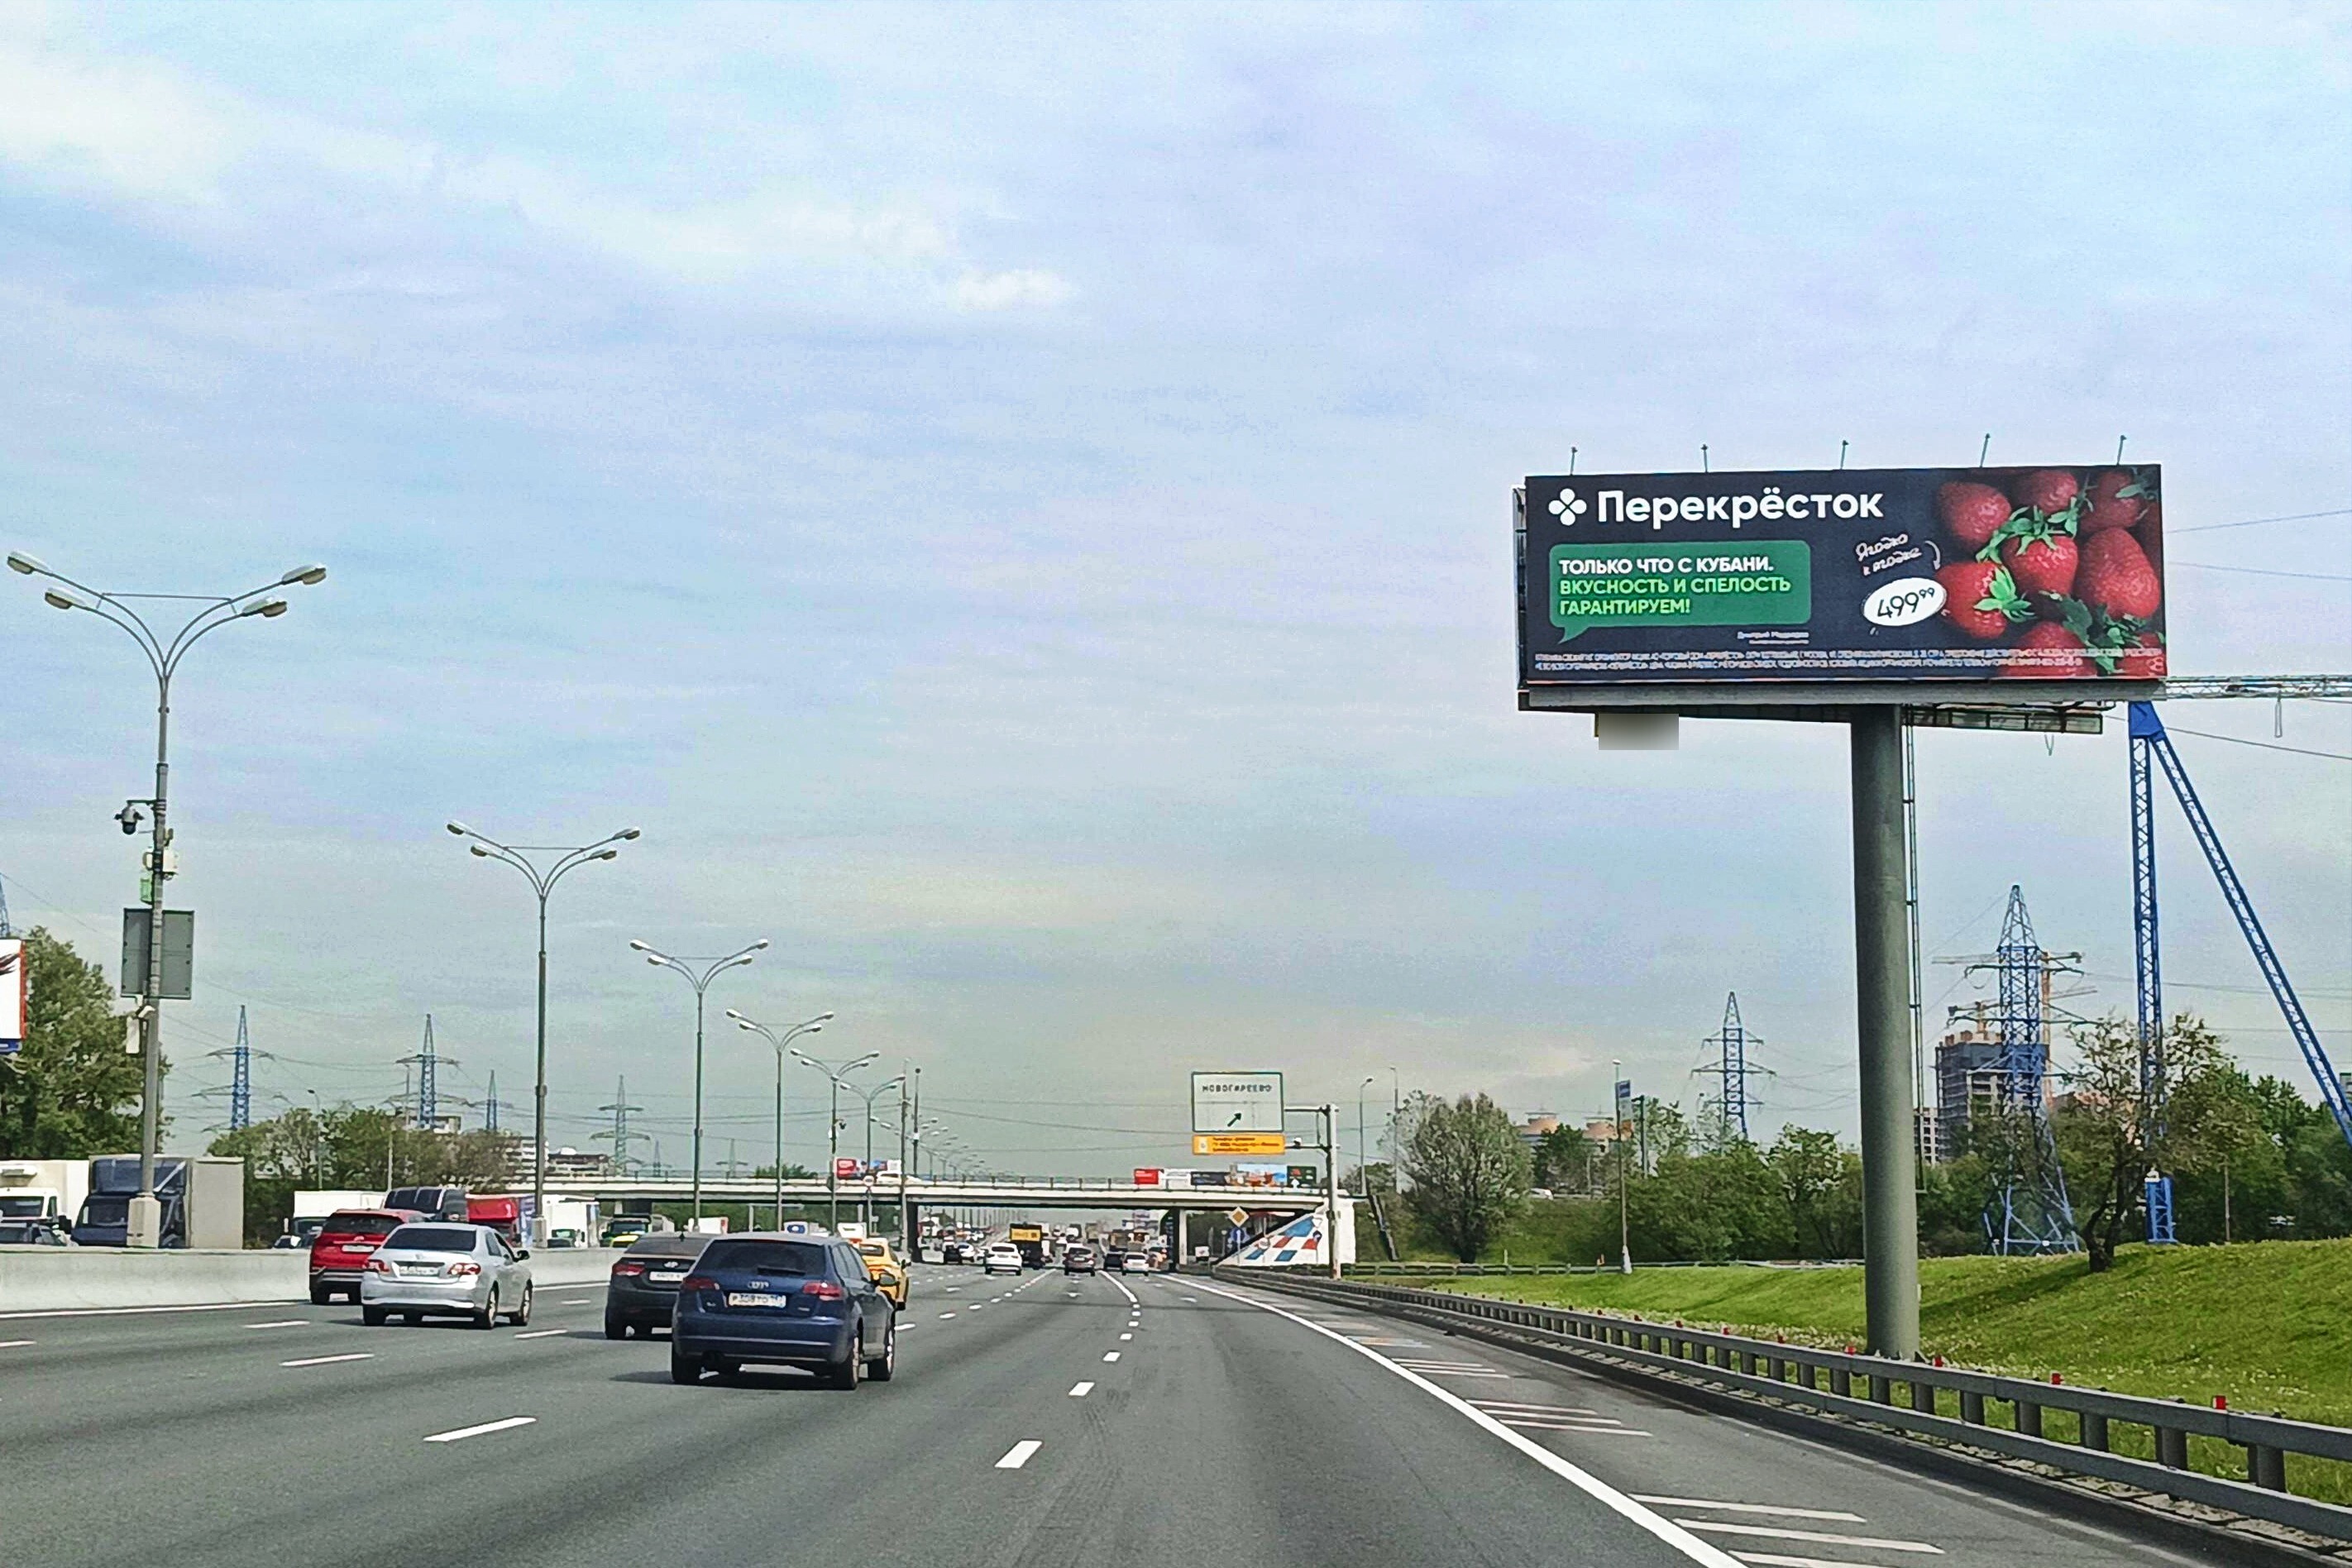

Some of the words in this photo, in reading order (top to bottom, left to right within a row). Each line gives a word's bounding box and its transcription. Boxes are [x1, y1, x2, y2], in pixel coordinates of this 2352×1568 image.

[1597, 486, 1884, 529] Перекрёсток
[1558, 558, 1633, 575] ТОЛЬКО
[1636, 557, 1675, 574] ЧТО
[1677, 557, 1693, 573] С
[1696, 556, 1775, 573] КУБАНИ.
[1560, 579, 1670, 595] ВКУСНОСТЬ
[1673, 578, 1686, 593] И
[1690, 576, 1792, 593] СПЕЛОСТЬ
[1560, 599, 1690, 615] ГАРАНТИРУЕМ!
[1202, 1083, 1273, 1092] НОВОГИРЕЕВО
